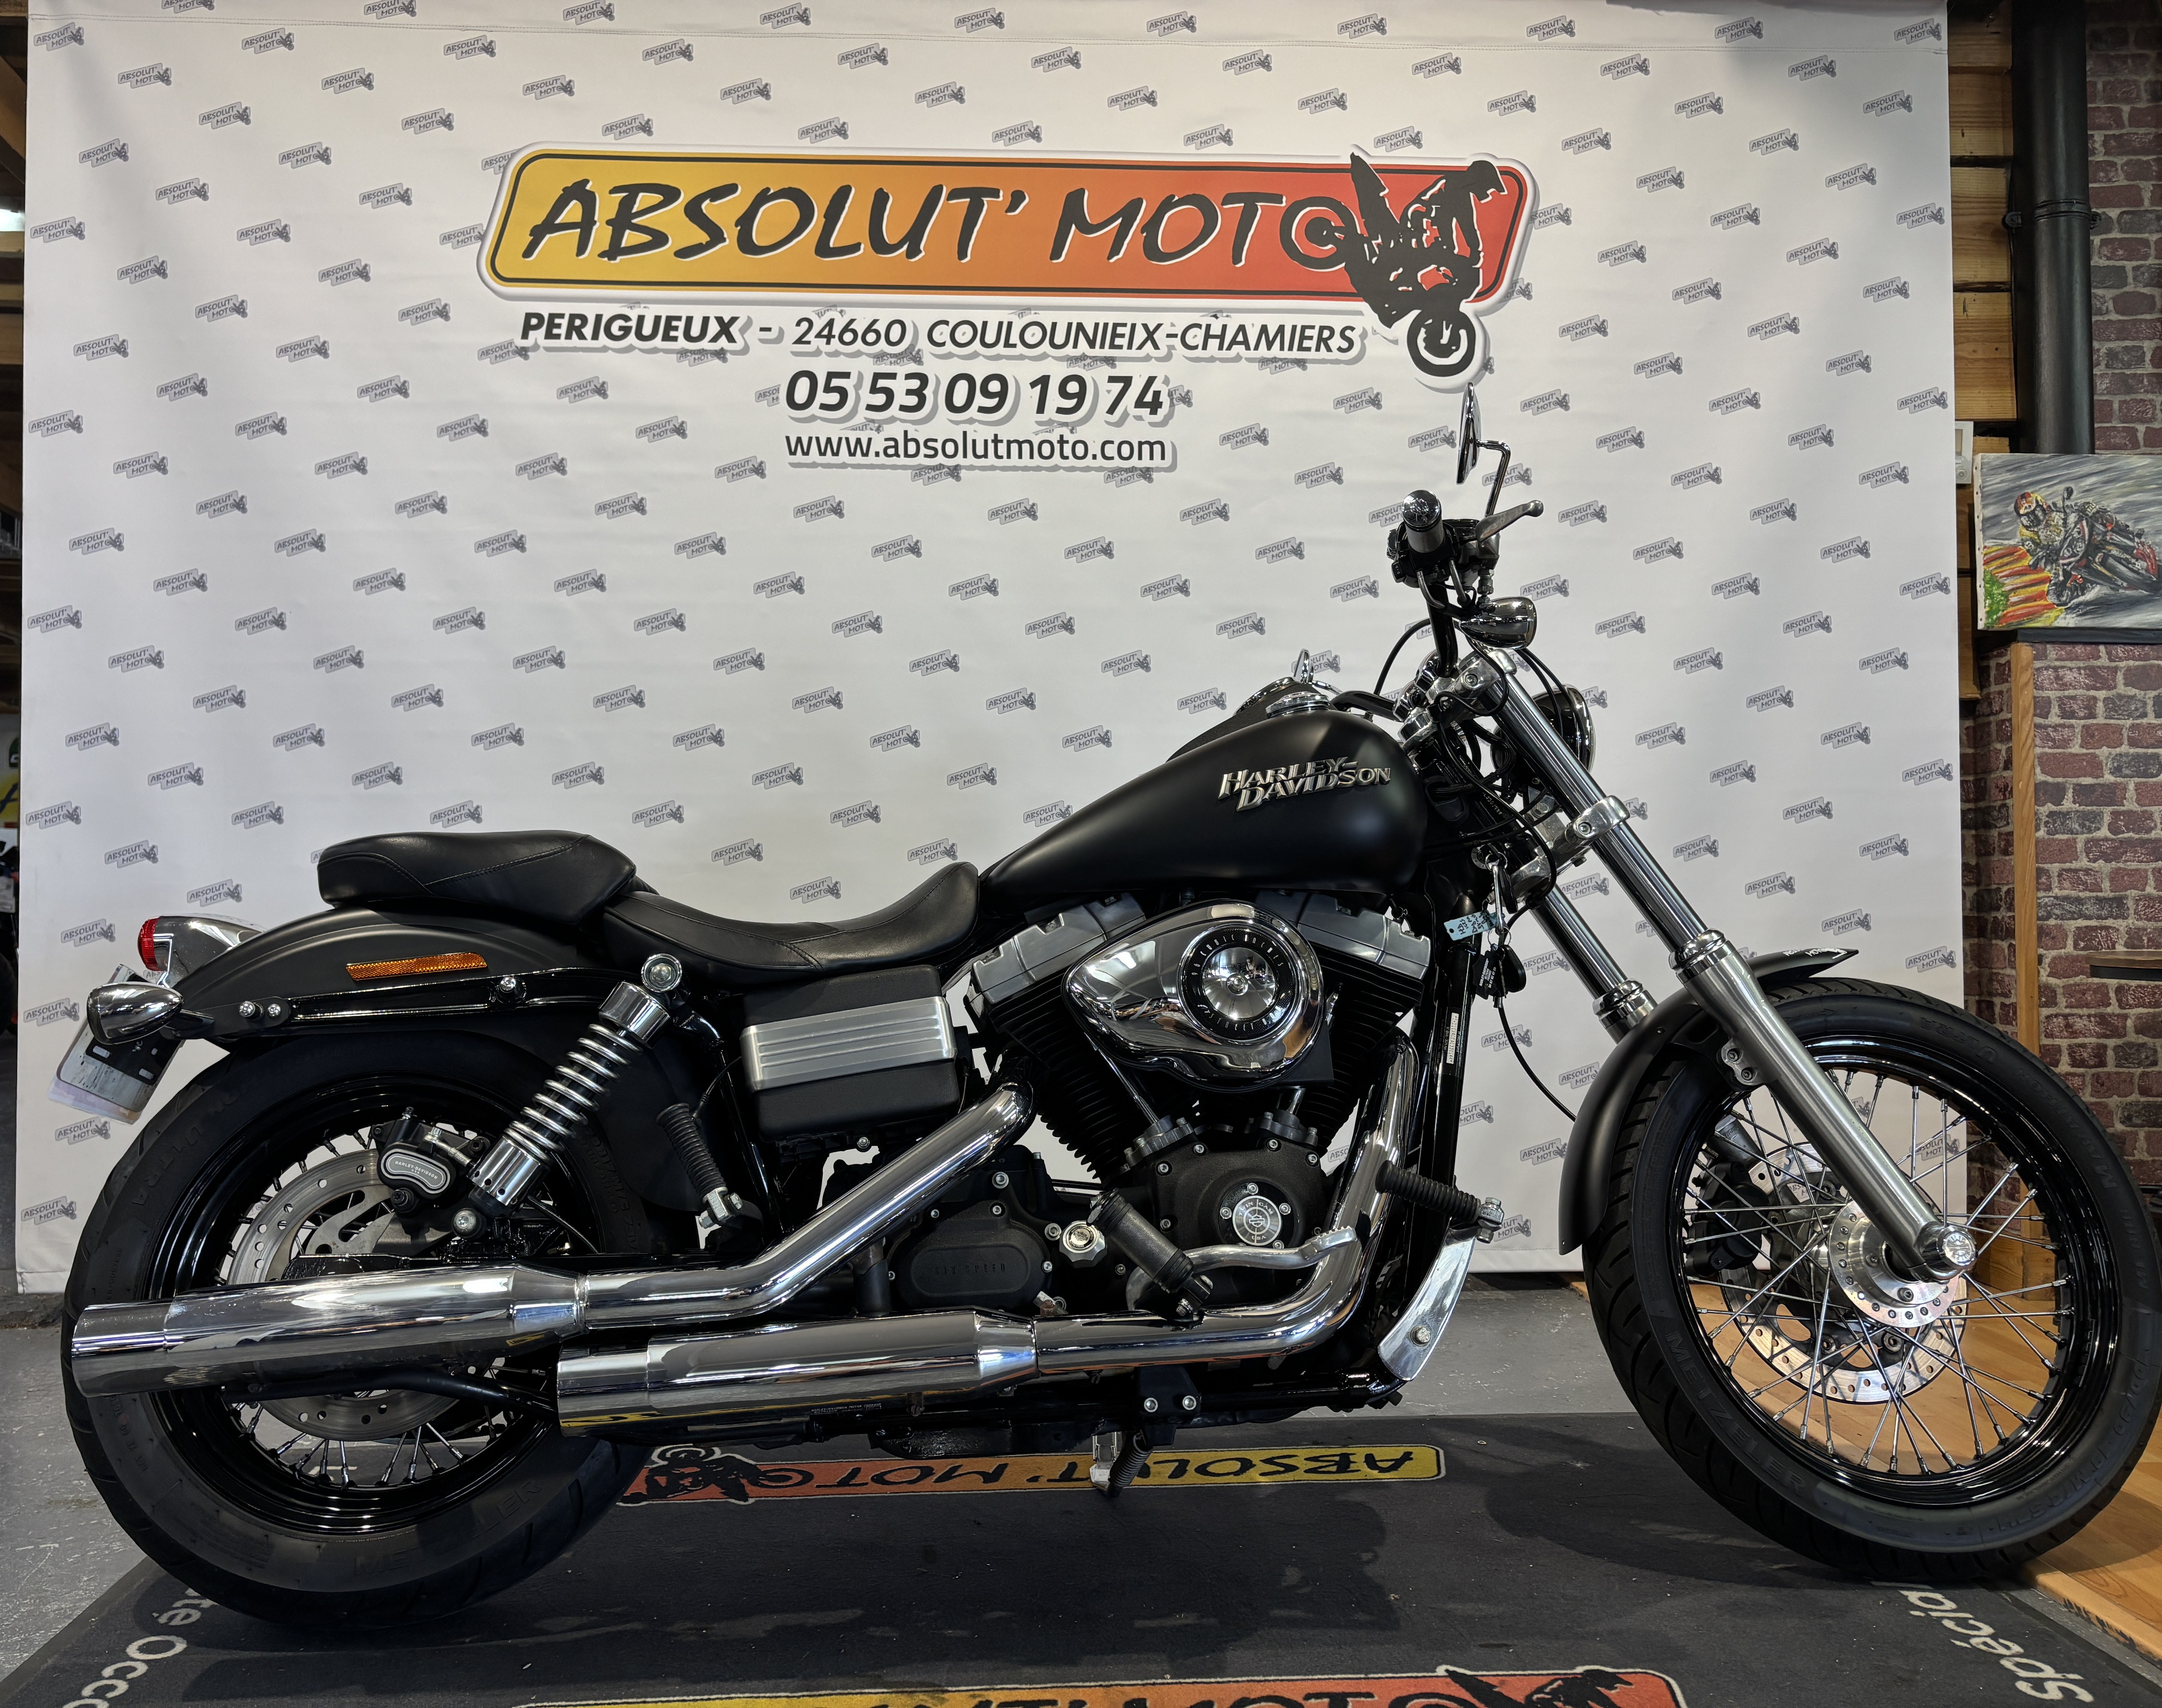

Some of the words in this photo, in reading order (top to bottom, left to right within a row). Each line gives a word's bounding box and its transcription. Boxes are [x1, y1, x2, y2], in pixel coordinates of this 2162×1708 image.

[522, 179, 1026, 260] ABSOLUT'
[521, 313, 739, 343] PERIGUEUX
[792, 317, 906, 346] 24660
[927, 320, 1355, 353] COULOUNIEIX-CHAMIERS
[786, 370, 851, 411] 05
[865, 372, 929, 413] 53
[945, 373, 1008, 414] 09
[1030, 374, 1087, 415] 19
[1106, 376, 1163, 415] 74
[785, 430, 1165, 461] www.absolutmoto.com
[1217, 756, 1358, 800] HARLEY-
[1236, 767, 1392, 812] DAVIDSON
[1200, 934, 1235, 956] CUBIC
[1244, 934, 1284, 966] INCHES
[1209, 1013, 1254, 1031] STREET
[1920, 1017, 1998, 1063] ULTRA
[394, 1160, 438, 1180] HARLEY-DAVIDSON
[1238, 1201, 1254, 1216] TWIN
[1258, 1202, 1274, 1215] CAM
[935, 1266, 956, 1275] SIX
[965, 1263, 1005, 1273] SPEED
[1665, 1331, 1846, 1494] METZELER
